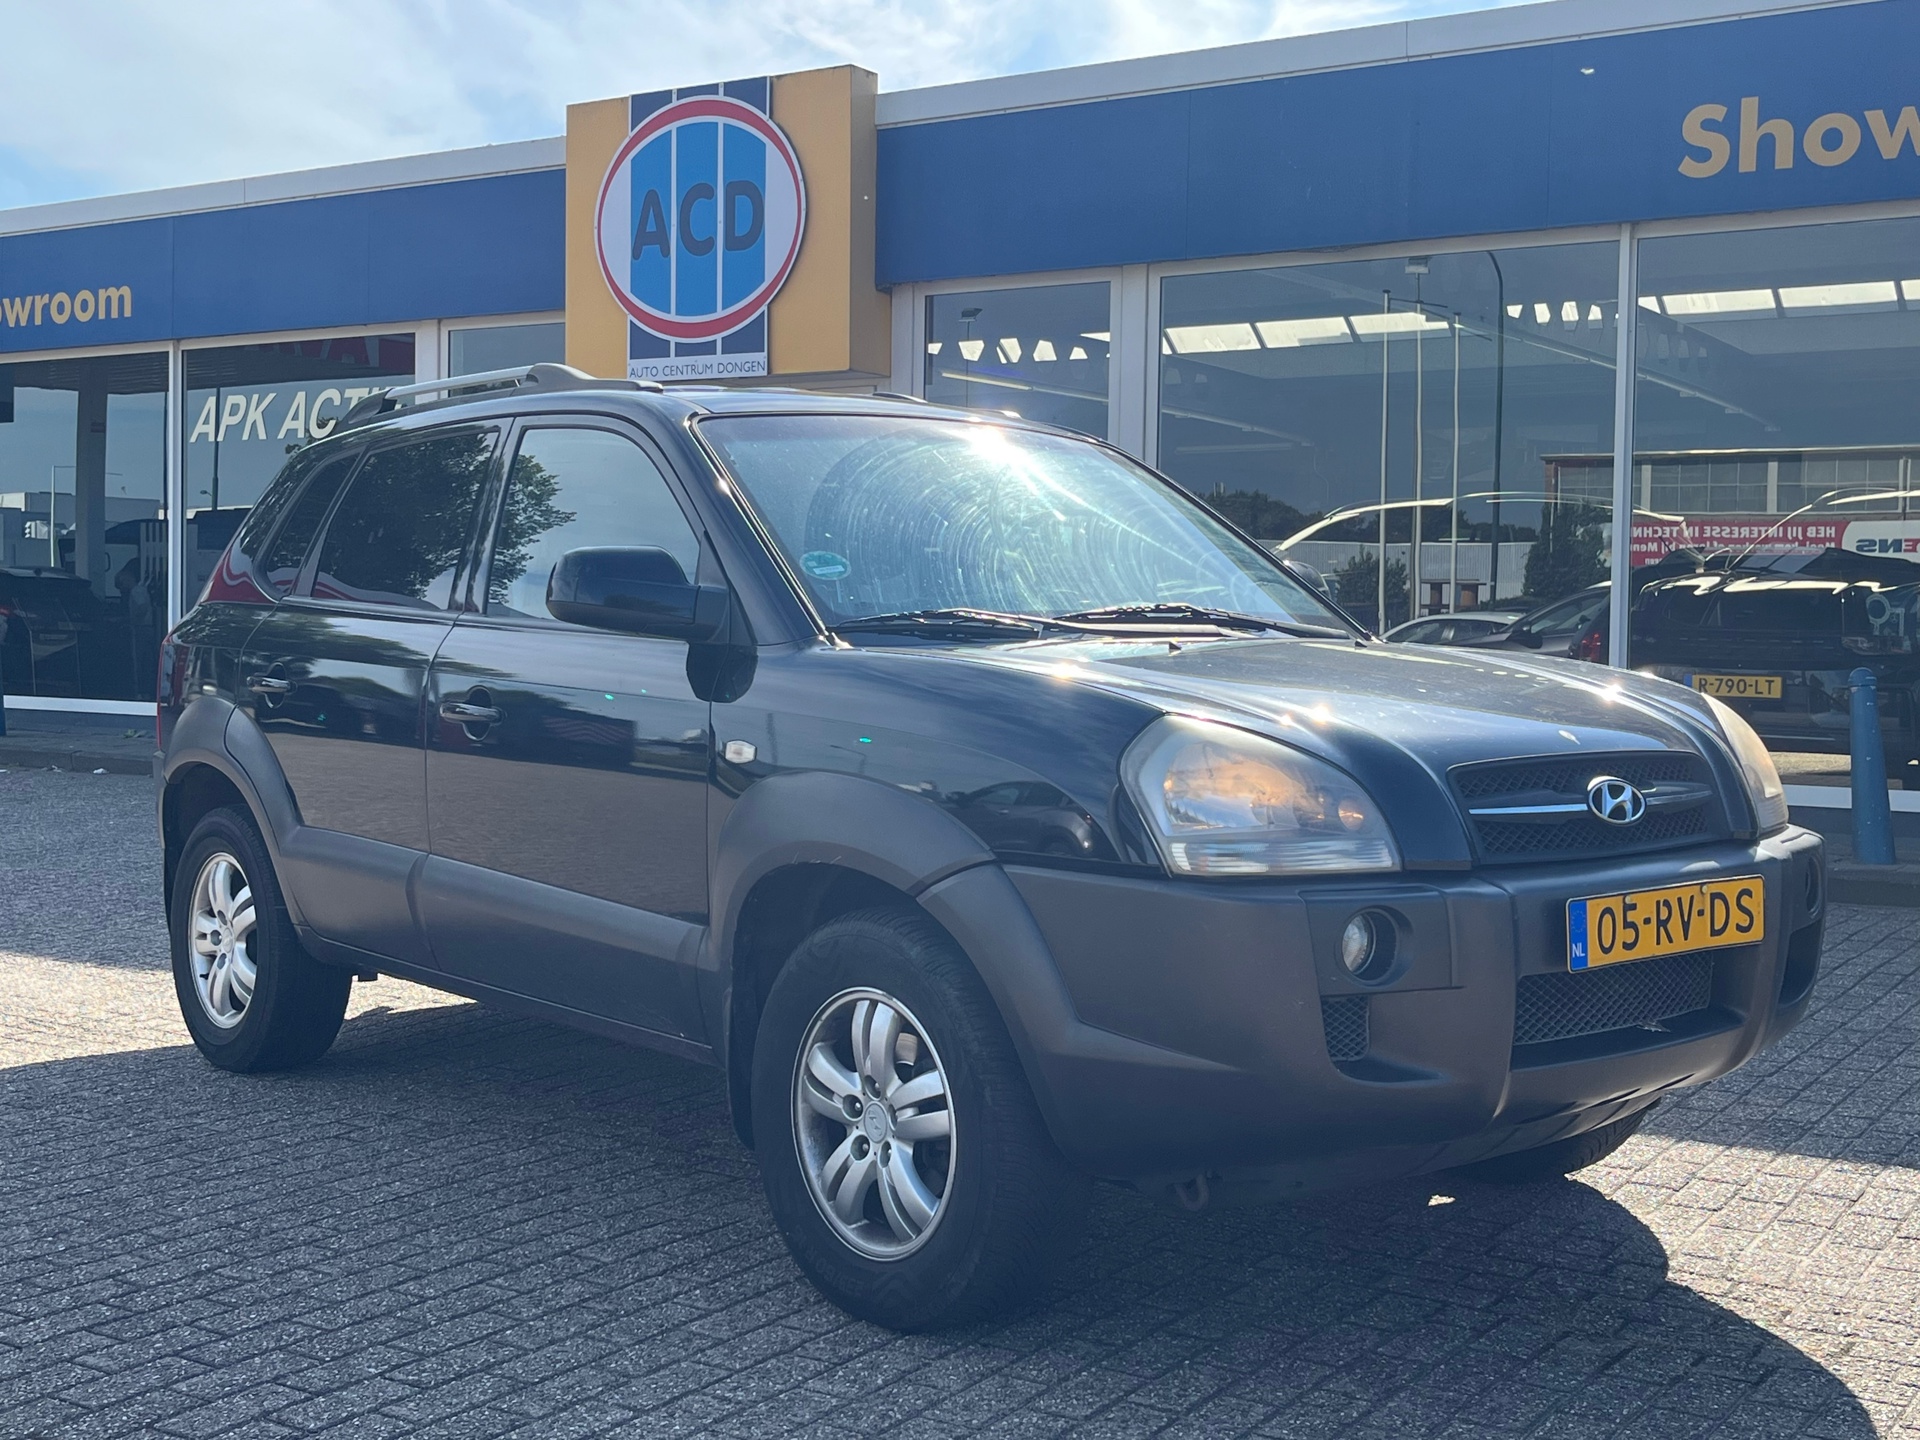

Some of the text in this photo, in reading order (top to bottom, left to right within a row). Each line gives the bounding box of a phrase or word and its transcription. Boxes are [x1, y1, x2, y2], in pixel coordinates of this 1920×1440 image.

[632, 180, 764, 260] ACD
[0, 286, 132, 328] wroom
[629, 361, 766, 379] AUTO CENTRUM DONGEN
[190, 393, 277, 443] APK
[1698, 677, 1775, 696] R-790-LT
[1597, 888, 1755, 955] 05-RV-DS
[1572, 943, 1586, 958] NL
